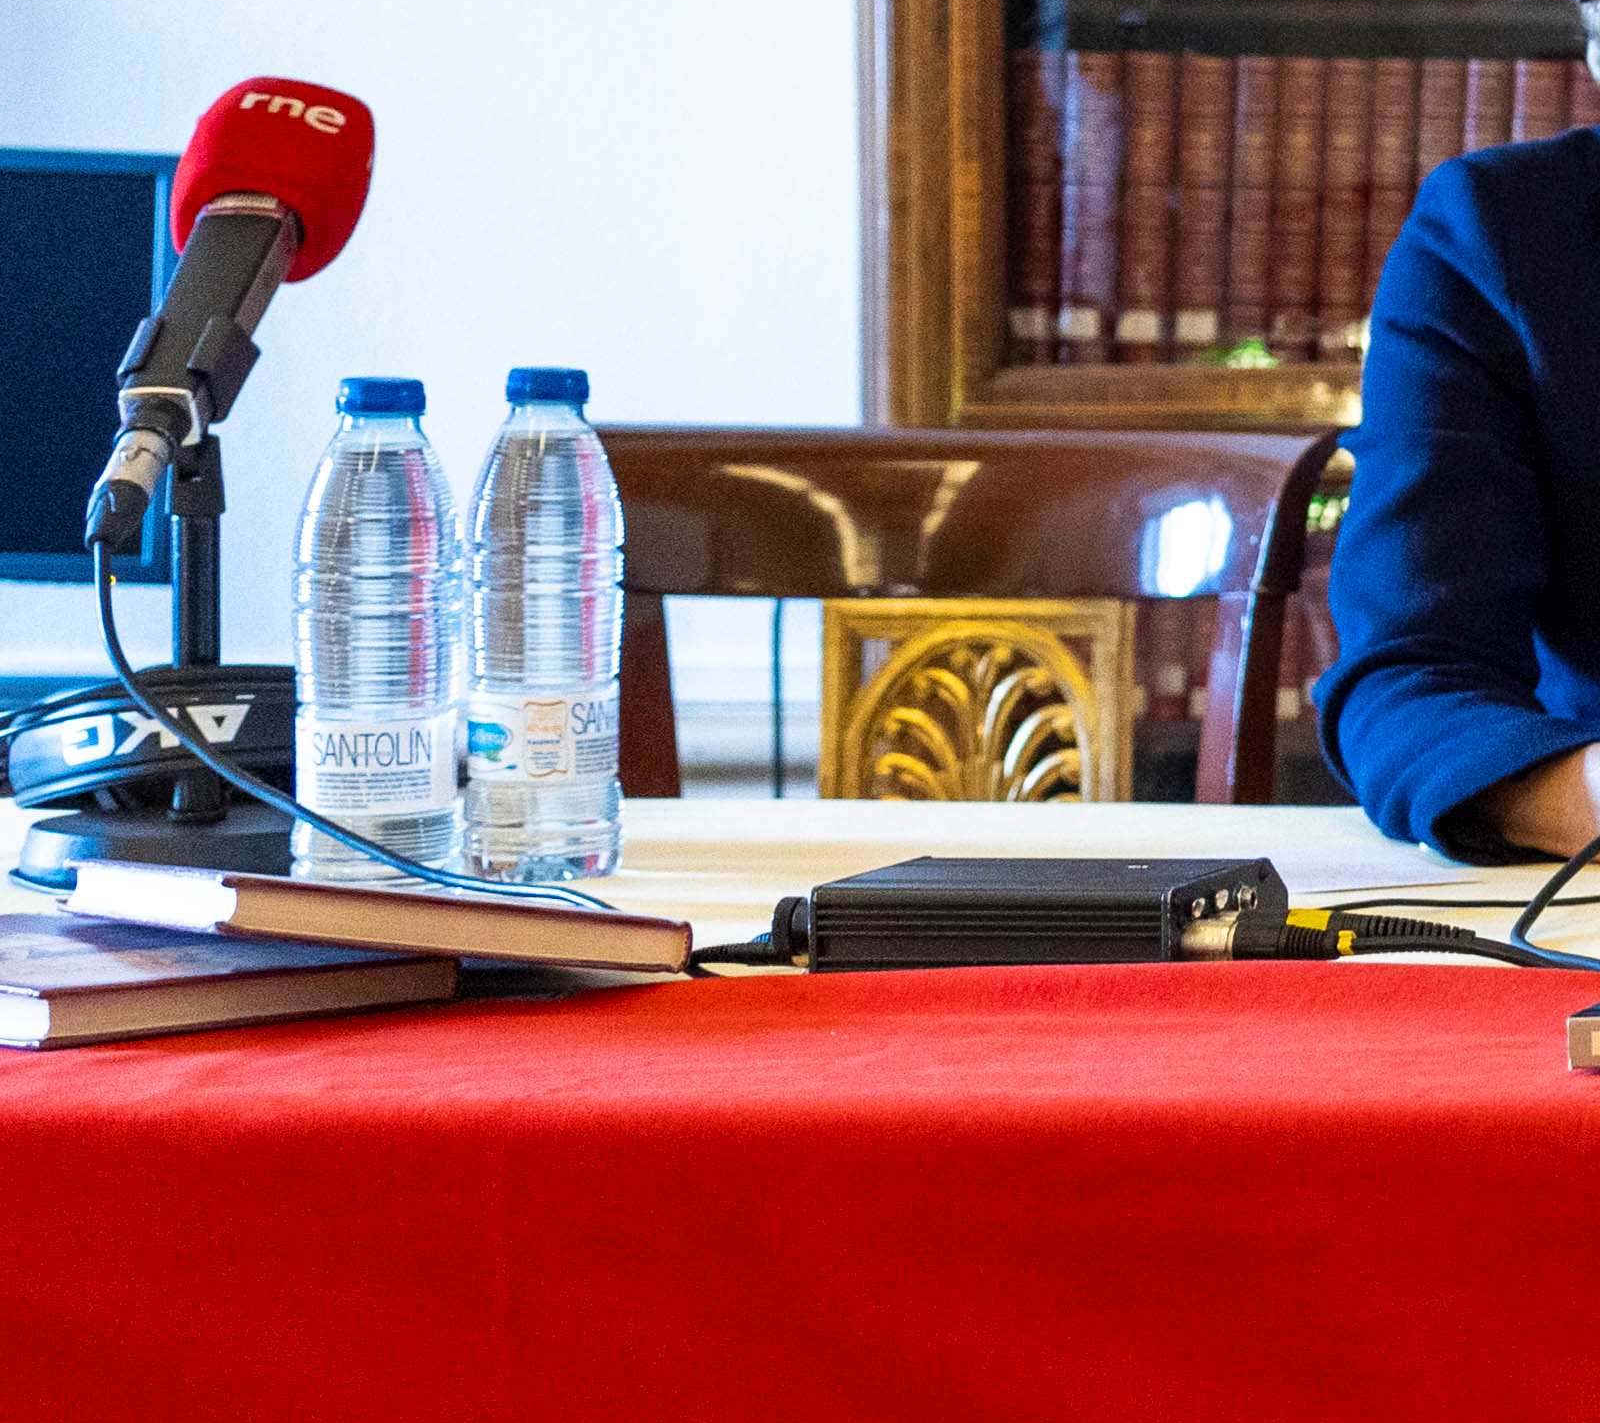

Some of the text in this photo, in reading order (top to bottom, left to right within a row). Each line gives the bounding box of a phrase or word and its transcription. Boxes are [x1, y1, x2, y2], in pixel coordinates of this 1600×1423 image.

[240, 88, 346, 135] rne
[61, 703, 252, 767] AKG
[311, 727, 432, 769] SANTOLÍN
